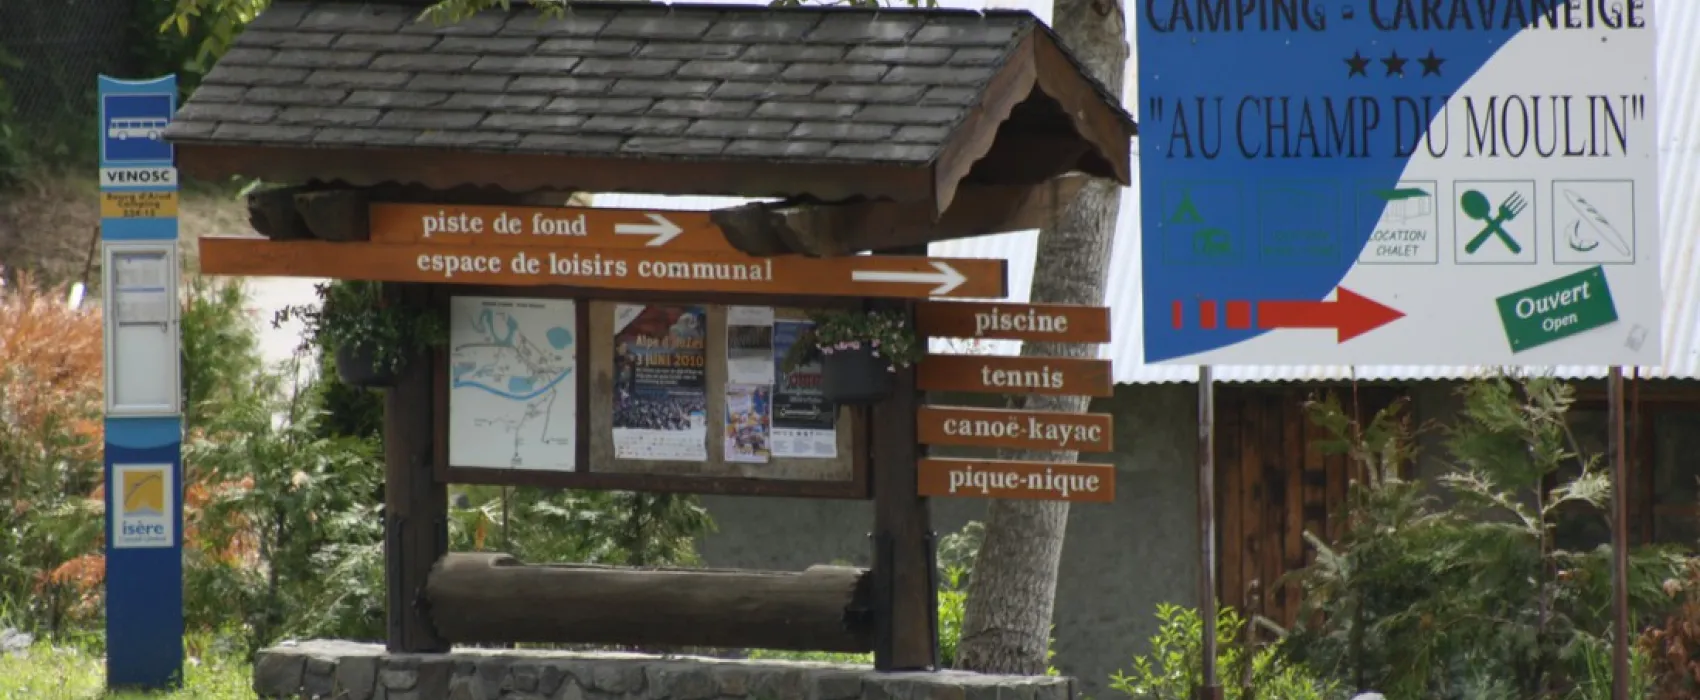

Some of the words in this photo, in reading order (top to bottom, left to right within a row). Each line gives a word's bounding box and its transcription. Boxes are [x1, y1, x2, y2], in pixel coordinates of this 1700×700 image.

[1145, 0, 1327, 32] CAMPING
[1370, 0, 1646, 31] CARAVANEIGE
[1235, 95, 1381, 159] CHAMP
[1391, 95, 1450, 158] DU
[107, 169, 170, 182] VENOSC
[422, 212, 484, 238] piste
[492, 212, 522, 235] de
[532, 213, 587, 237] fond
[1376, 244, 1419, 257] CHALET
[416, 254, 501, 278] espace
[511, 252, 541, 274] de
[549, 253, 628, 277] loisirs
[637, 255, 773, 281] communal
[1515, 280, 1592, 319] Ouvert
[974, 307, 1068, 336] piscine
[1542, 313, 1579, 333] Open
[675, 354, 704, 367] 2010
[981, 364, 1064, 389] tennis
[943, 416, 1102, 447] canoë-kayac
[948, 466, 1100, 497] pique-nique
[122, 519, 165, 535] isère
